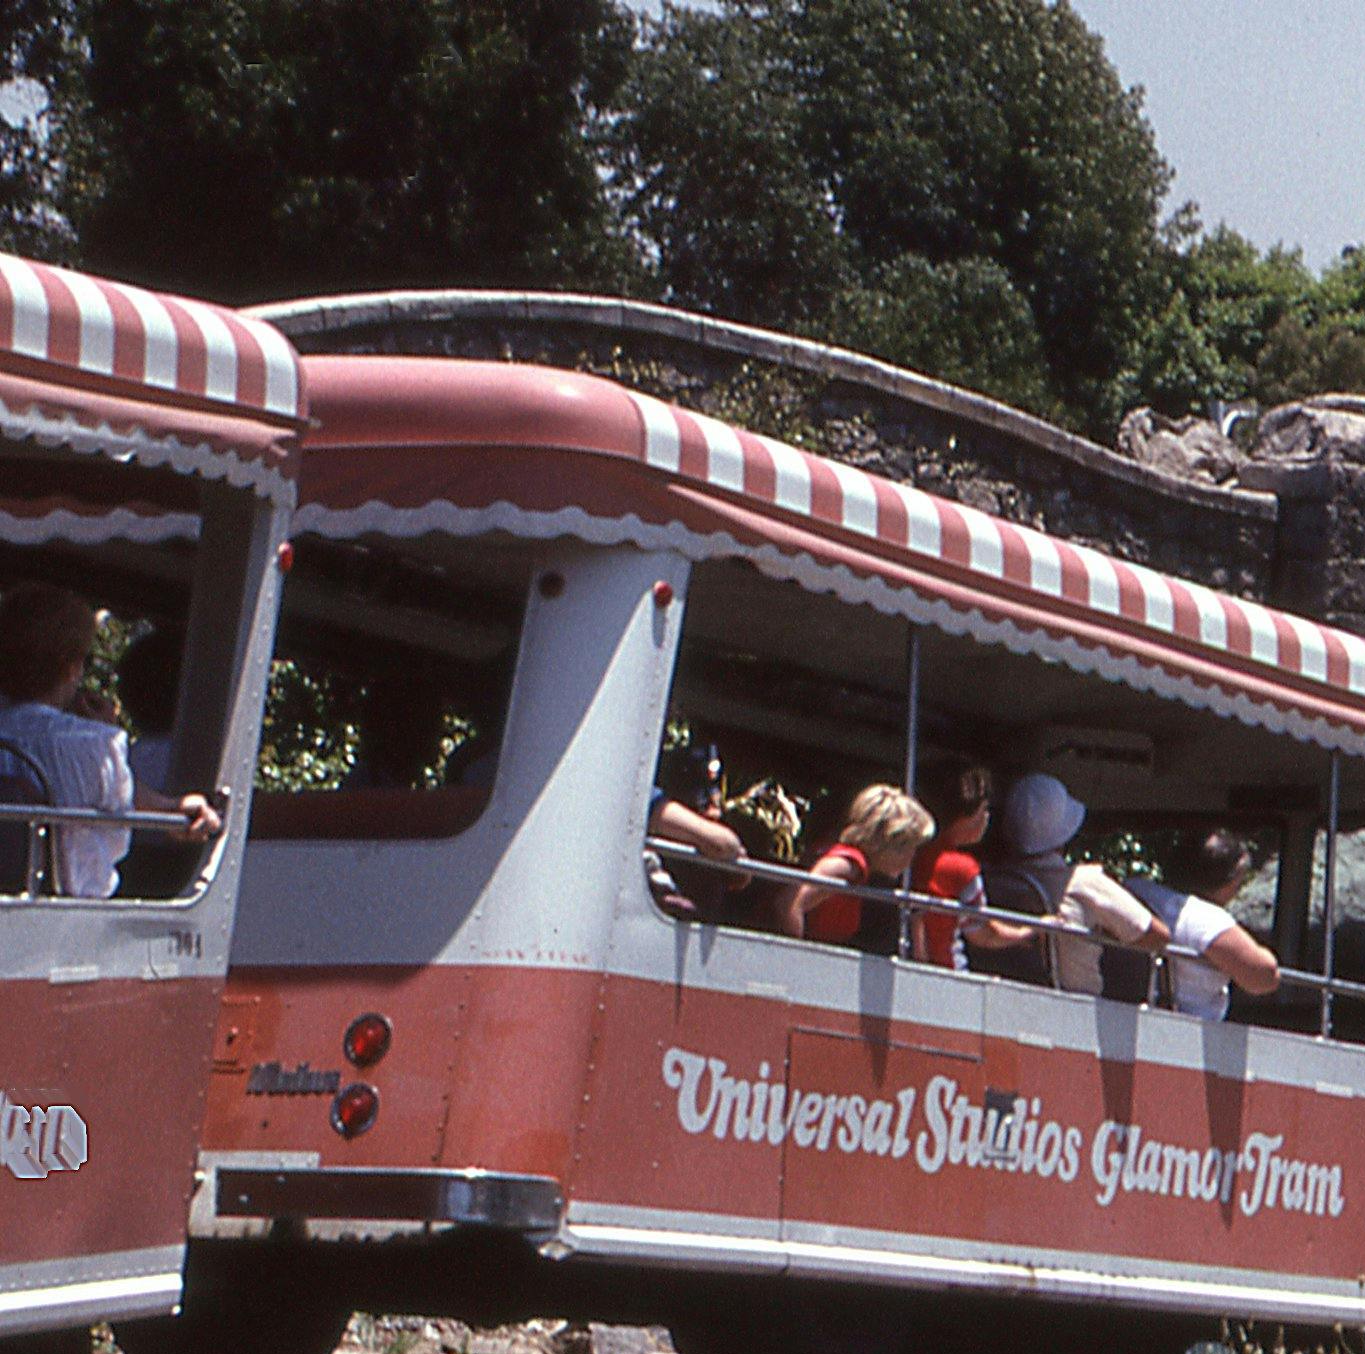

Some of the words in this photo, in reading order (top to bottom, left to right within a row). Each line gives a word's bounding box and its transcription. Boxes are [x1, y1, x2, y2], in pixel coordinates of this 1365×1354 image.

[662, 1047, 916, 1159] Universal
[915, 1075, 1083, 1183] Studios
[1090, 1119, 1244, 1207] Glamor
[1240, 1131, 1345, 1218] Tram
